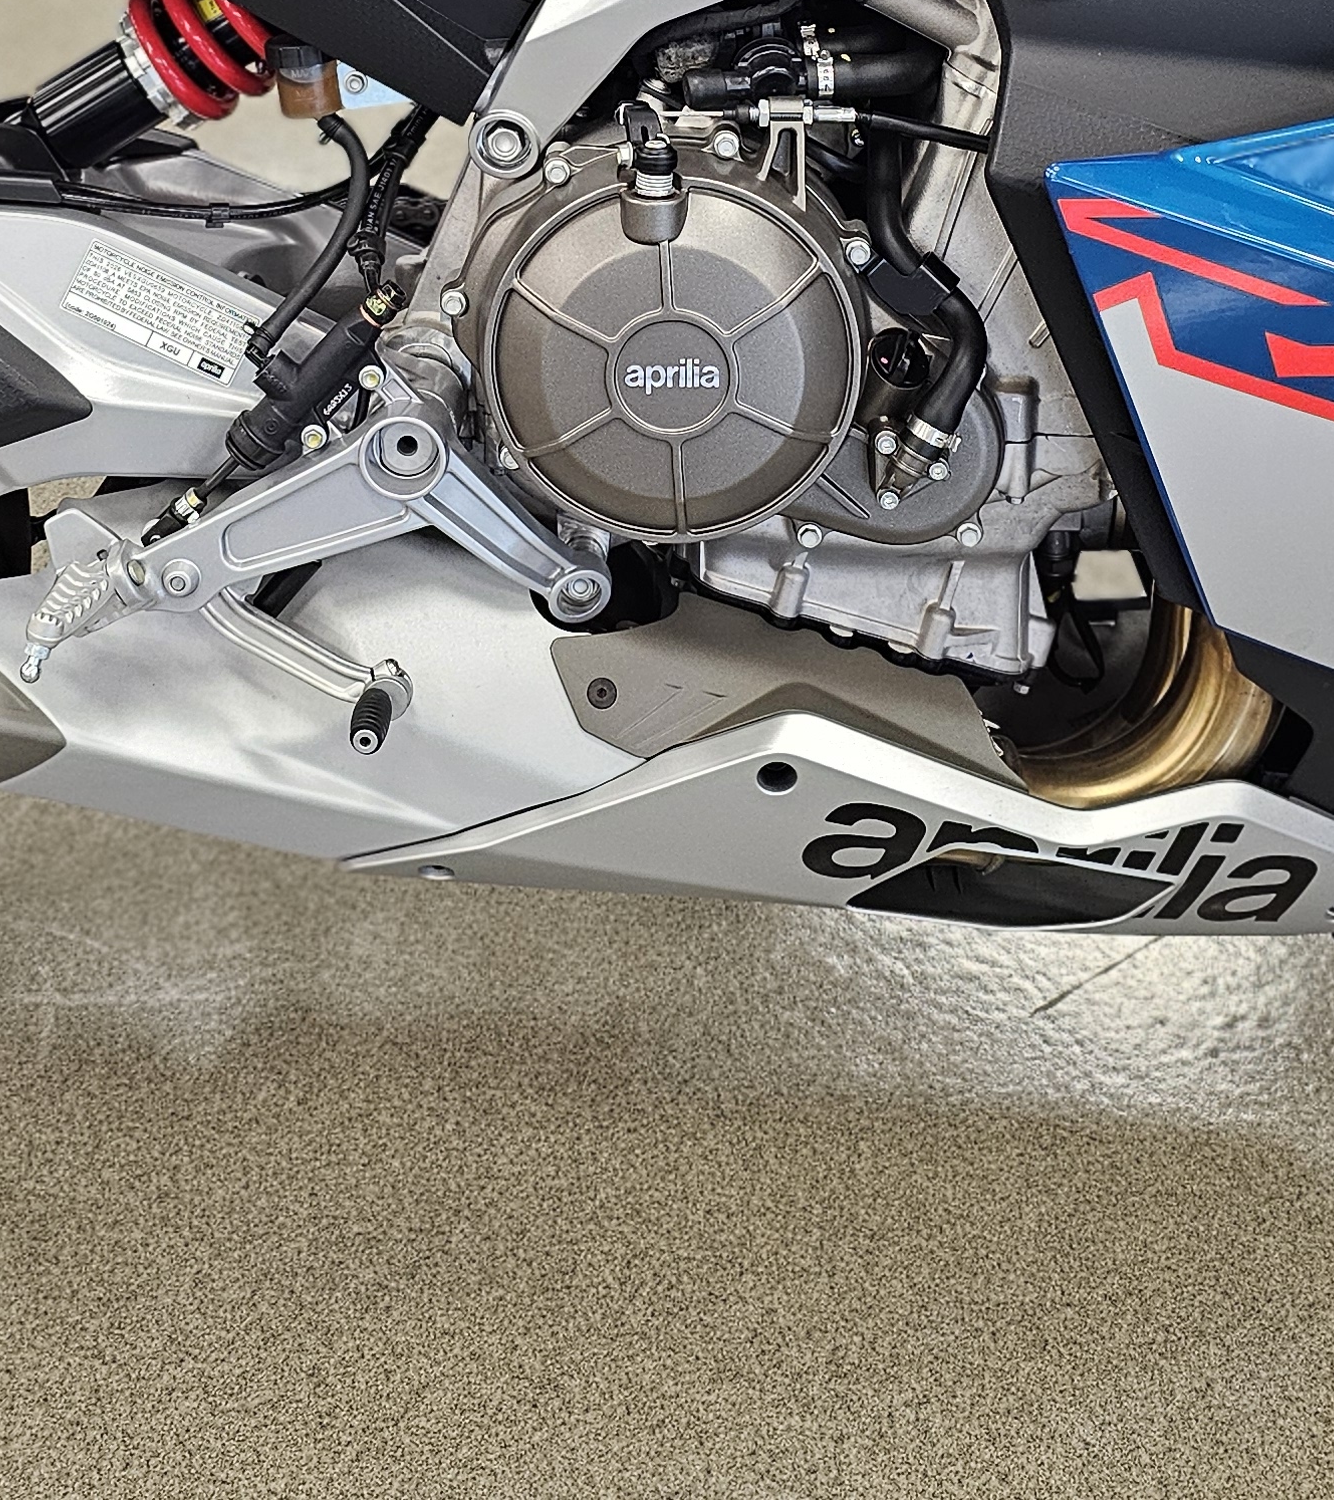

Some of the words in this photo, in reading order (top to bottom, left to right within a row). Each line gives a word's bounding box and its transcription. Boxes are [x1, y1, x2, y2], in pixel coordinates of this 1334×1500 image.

[92, 243, 136, 268] MOTORCYCLE
[135, 263, 155, 277] NOISE
[184, 287, 216, 306] CONTROL
[157, 340, 181, 357] XGU
[625, 358, 720, 395] aprilia
